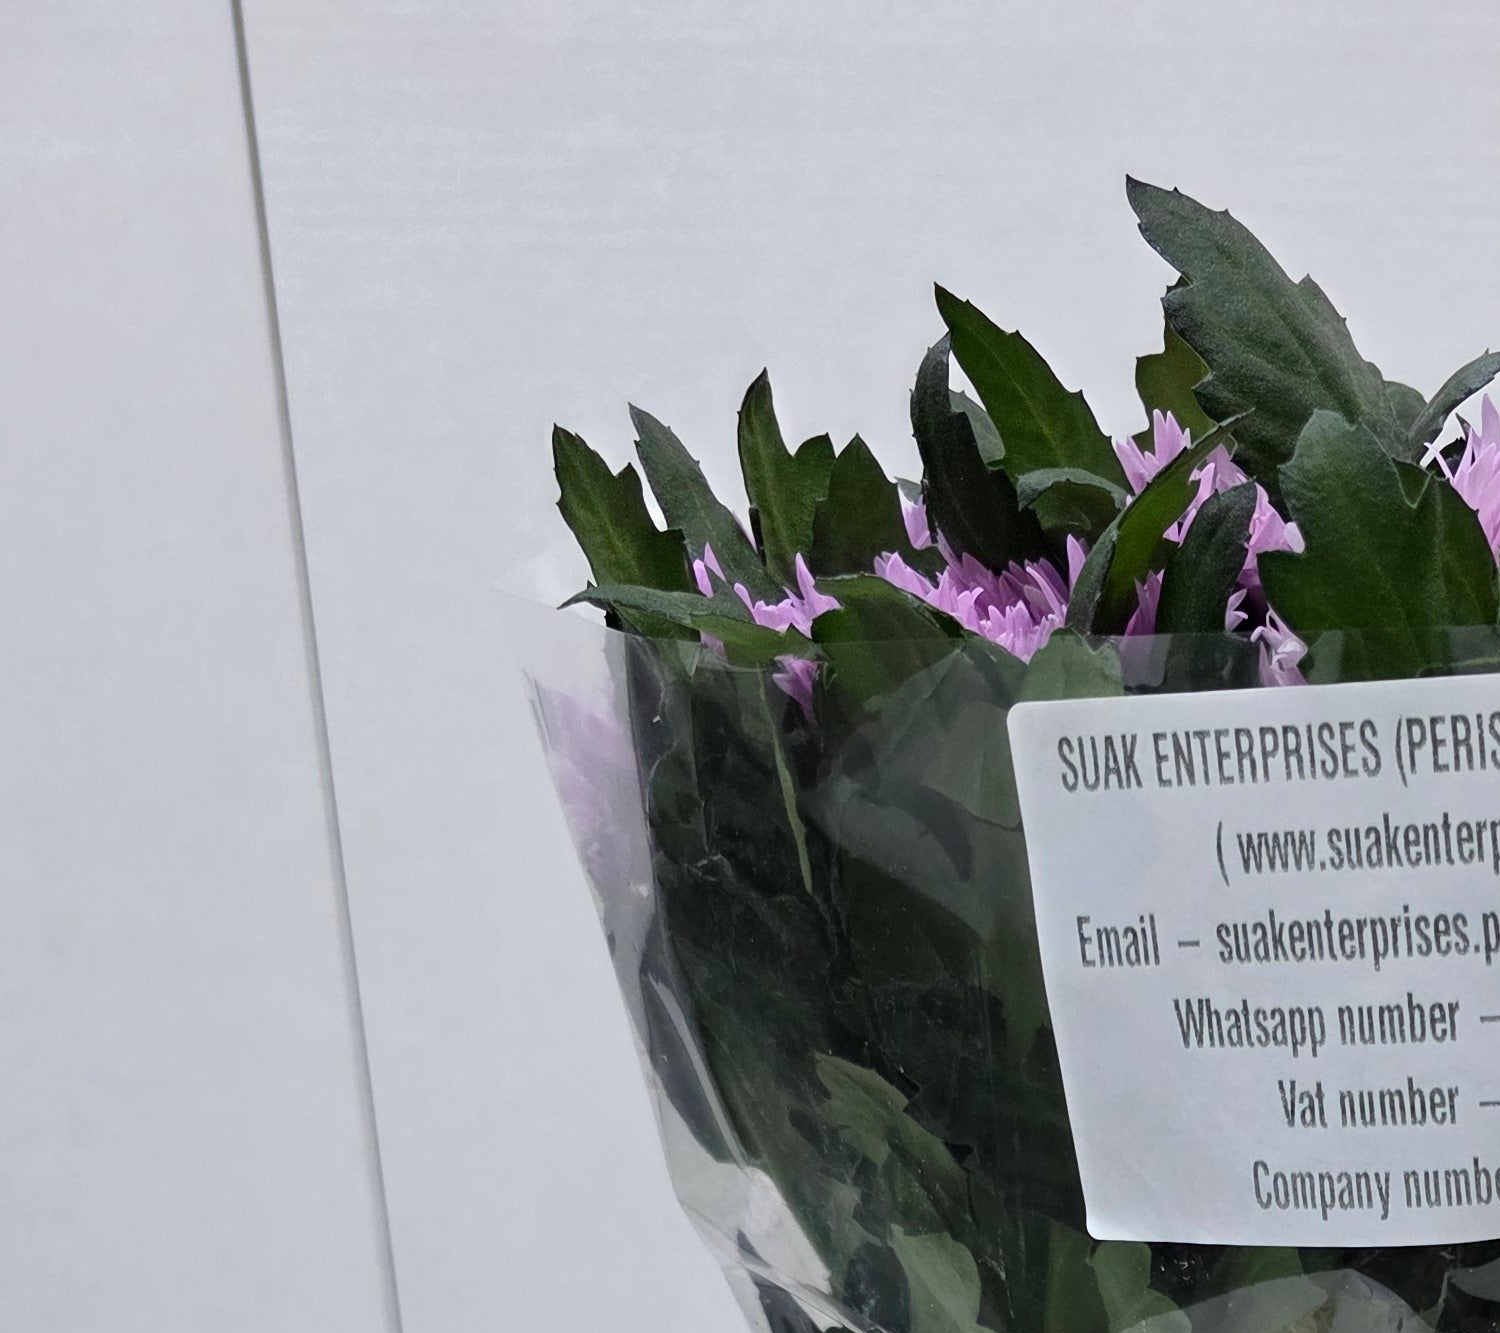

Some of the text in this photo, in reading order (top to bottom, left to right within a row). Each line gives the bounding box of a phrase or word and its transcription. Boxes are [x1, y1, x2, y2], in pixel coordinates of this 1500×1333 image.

[1057, 732, 1143, 793] SUAK
[1152, 719, 1382, 789] ENTERPRISES
[1076, 913, 1161, 969] Email
[1172, 997, 1327, 1058] Whatsapp
[1337, 992, 1460, 1046] number
[1277, 1079, 1328, 1129] Vat
[1339, 1076, 1460, 1129] number
[1252, 1159, 1391, 1222] Company
